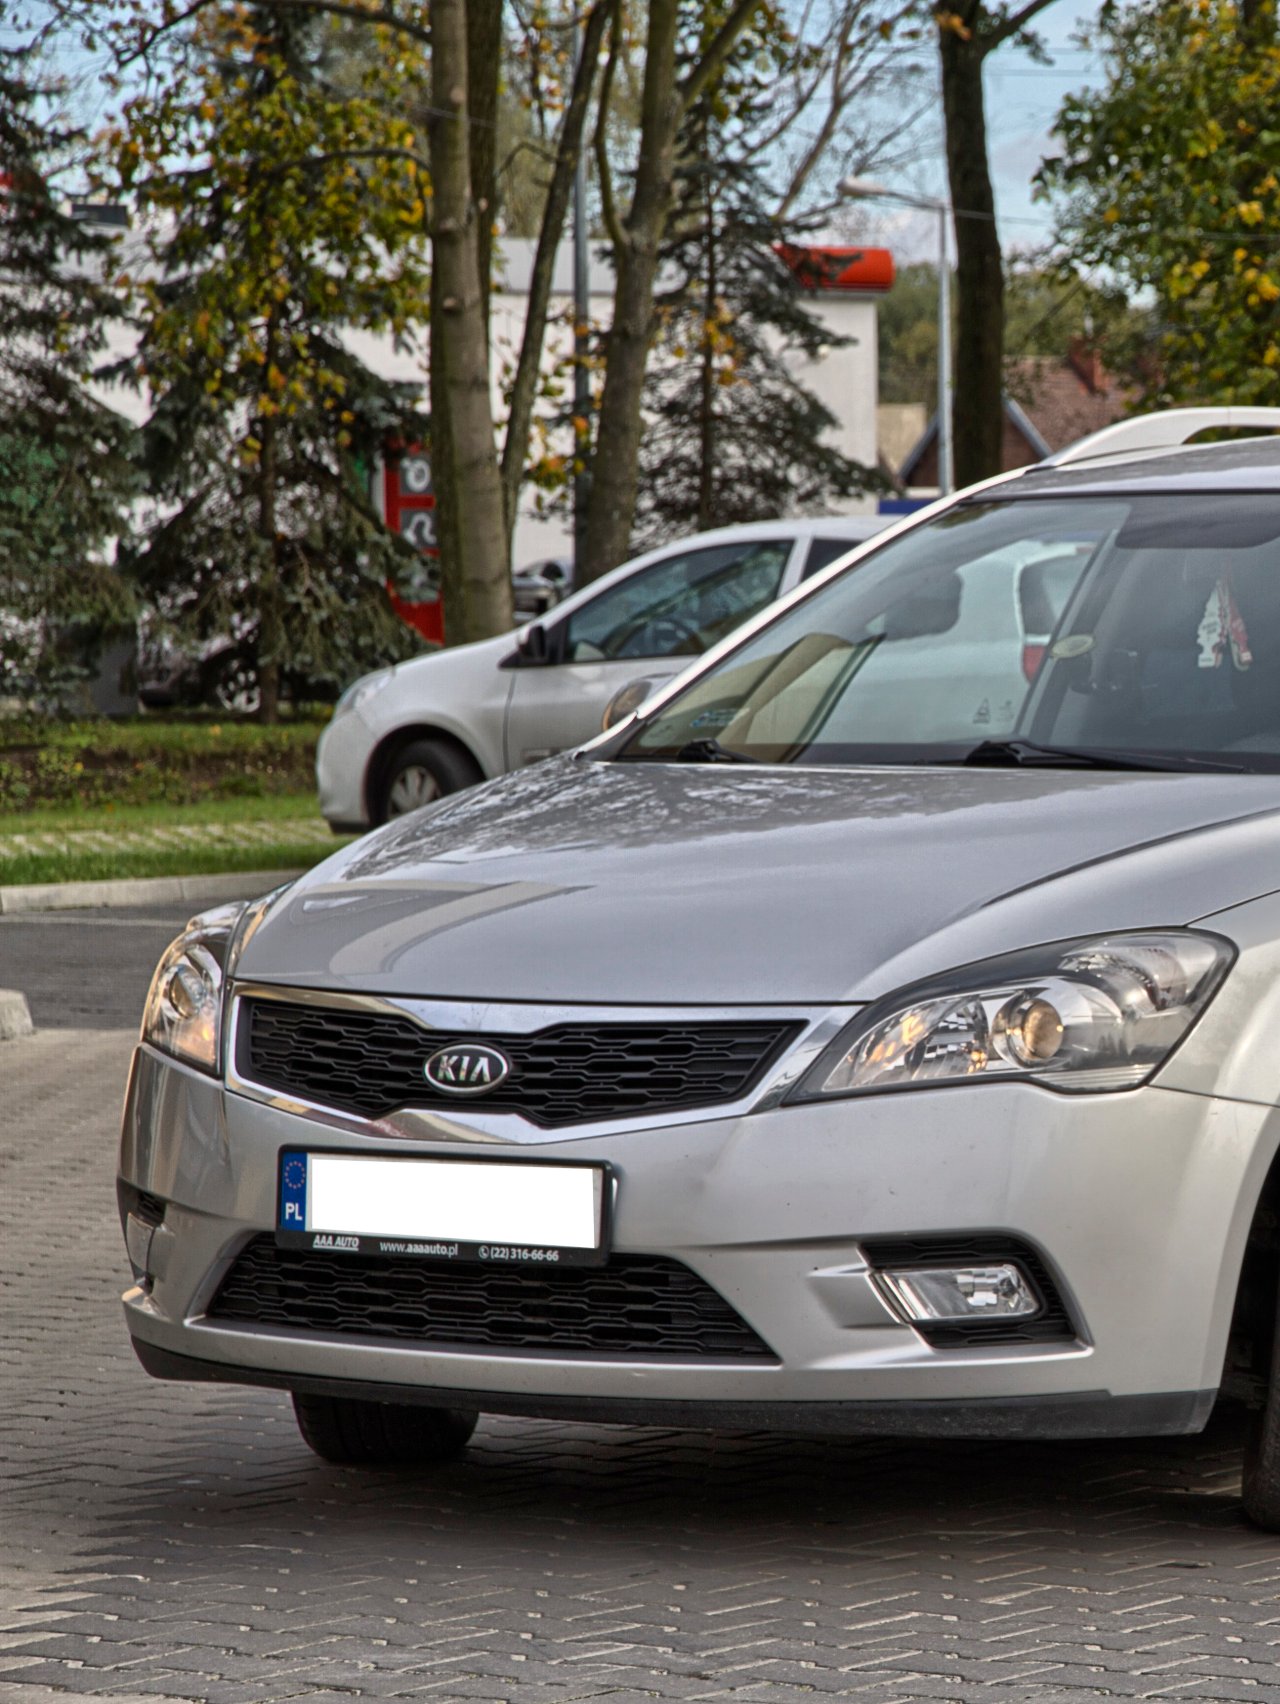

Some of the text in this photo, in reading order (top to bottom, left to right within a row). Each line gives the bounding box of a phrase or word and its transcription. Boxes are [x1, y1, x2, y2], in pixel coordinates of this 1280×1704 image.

[438, 1054, 491, 1082] KIA
[285, 1202, 303, 1221] PL
[313, 1234, 560, 1262] AAA AUTO www.aaaauto.pl (22) 316-66-66
